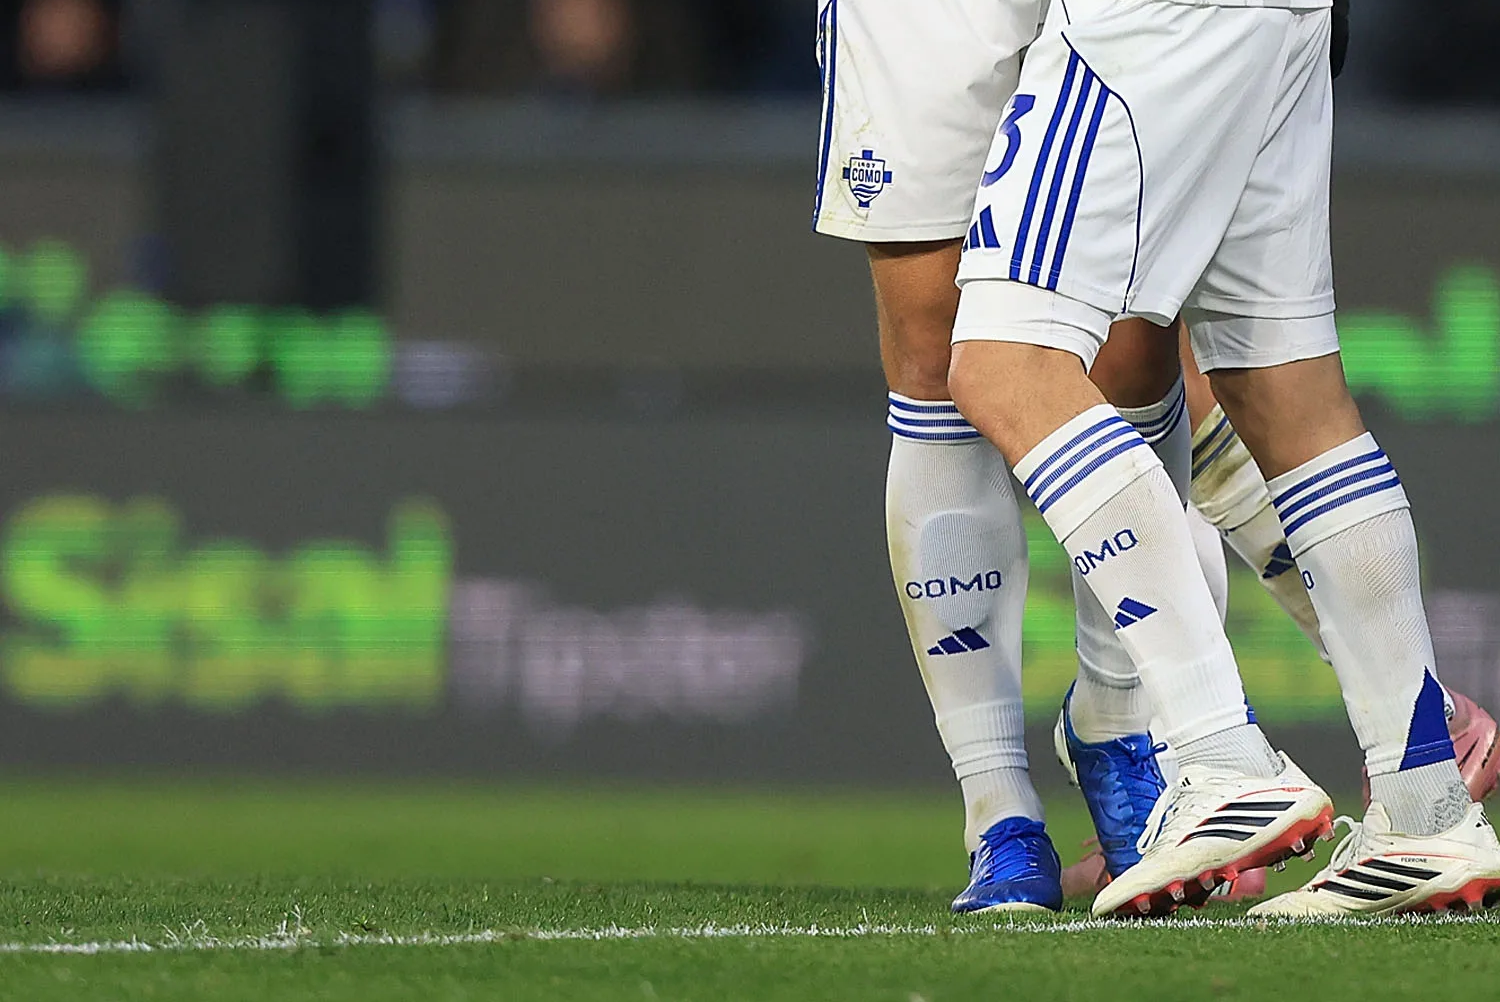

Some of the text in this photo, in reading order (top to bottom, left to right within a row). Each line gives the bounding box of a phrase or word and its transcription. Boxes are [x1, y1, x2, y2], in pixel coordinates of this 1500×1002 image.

[980, 93, 1036, 188] 3
[851, 167, 881, 184] COMO
[905, 570, 1002, 600] COMO
